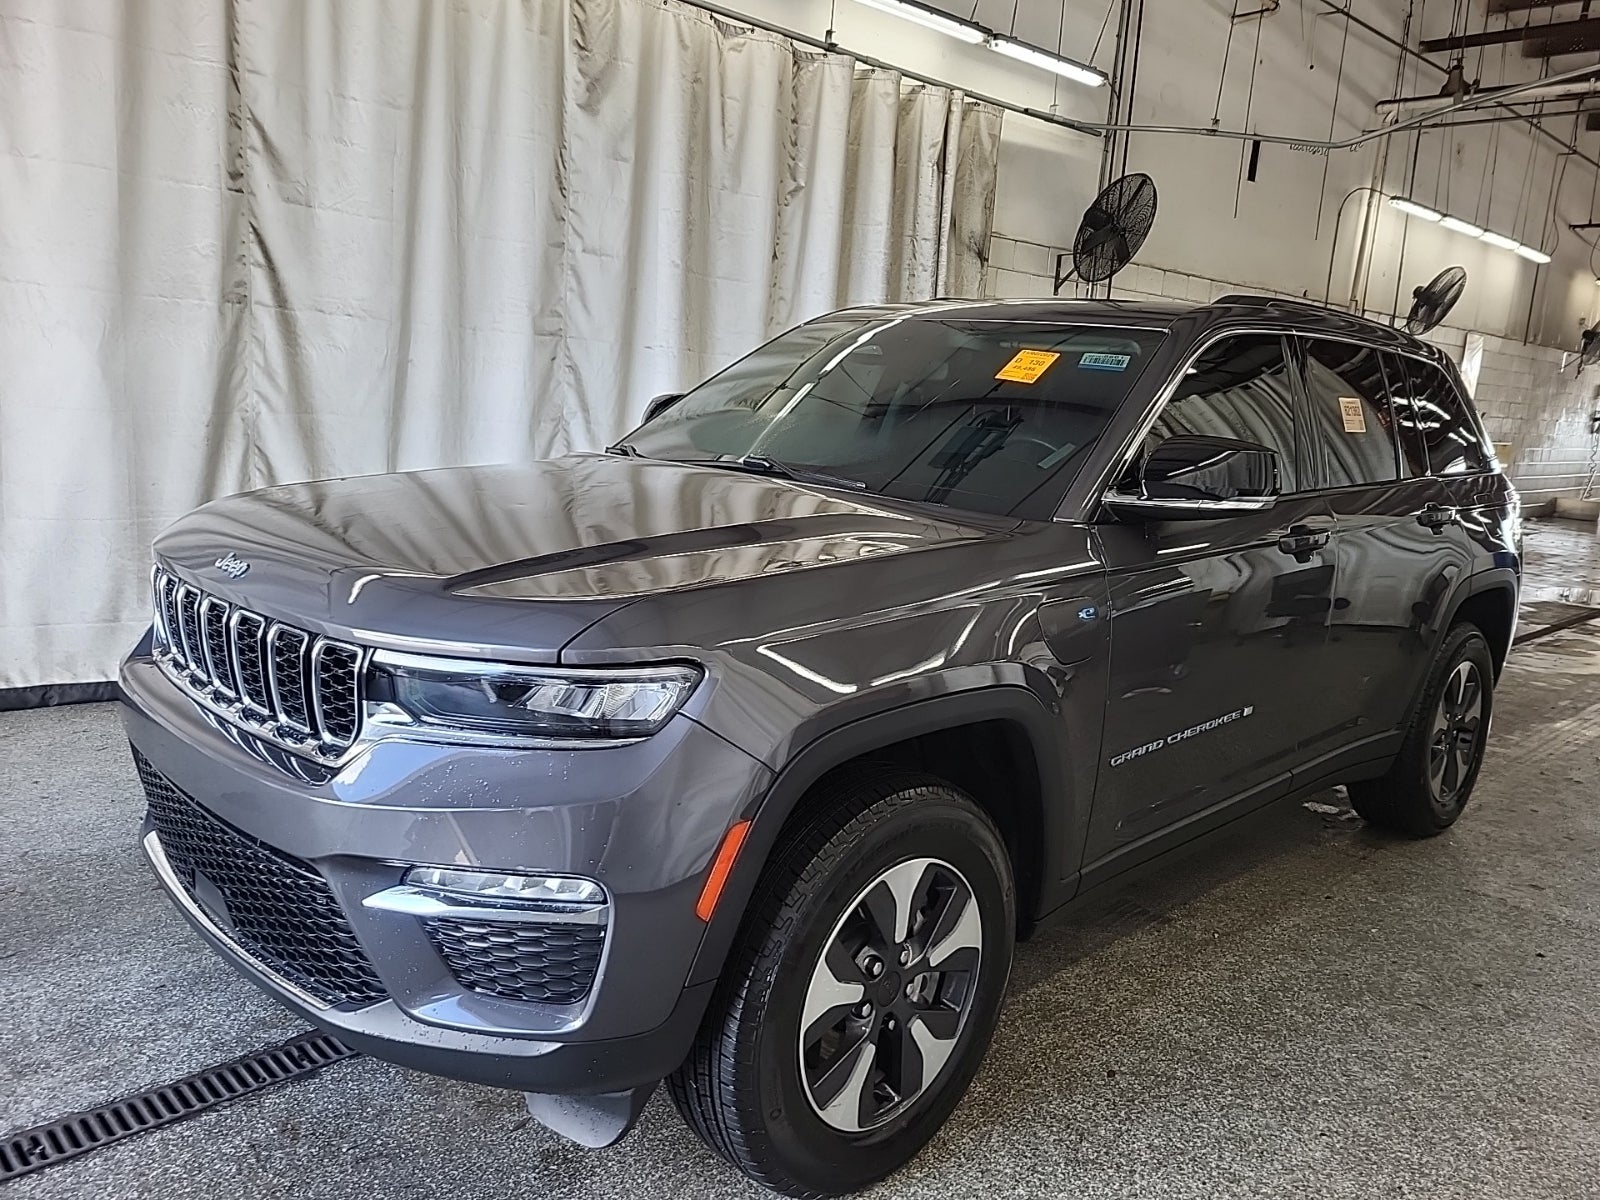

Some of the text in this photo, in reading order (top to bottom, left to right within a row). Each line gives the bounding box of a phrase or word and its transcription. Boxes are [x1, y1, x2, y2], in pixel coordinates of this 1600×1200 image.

[214, 551, 249, 579] Jeep
[1110, 710, 1242, 767] GRAND CHEROKEE
